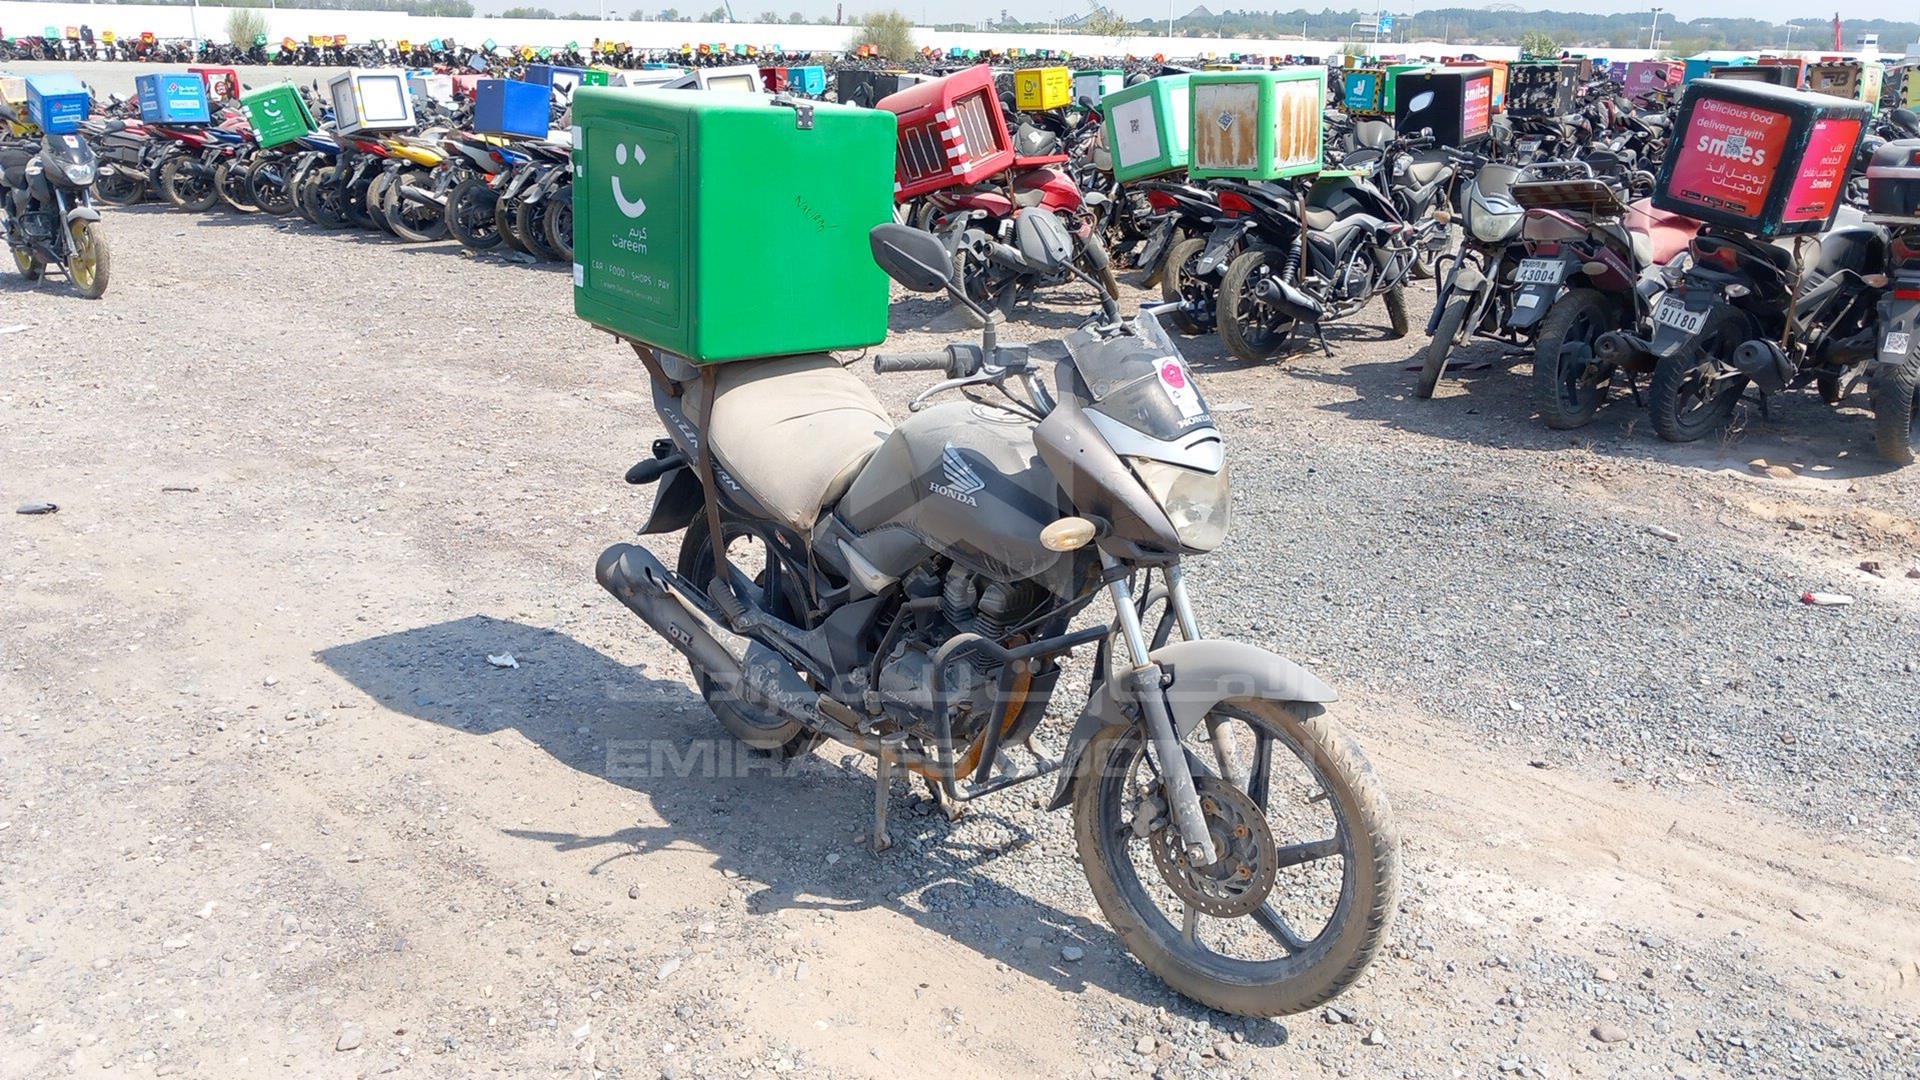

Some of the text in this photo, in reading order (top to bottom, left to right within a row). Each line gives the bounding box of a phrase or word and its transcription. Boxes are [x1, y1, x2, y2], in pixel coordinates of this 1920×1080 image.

[1702, 100, 1775, 125] Delicious food
[1696, 117, 1765, 142] delivered with
[611, 233, 648, 255] Careem
[628, 227, 648, 241] كريم
[591, 259, 671, 291] CAR FOOD SHOPS PAY
[1520, 269, 1556, 282] 43004
[1659, 307, 1697, 331] 91180
[928, 481, 978, 508] HONDA
